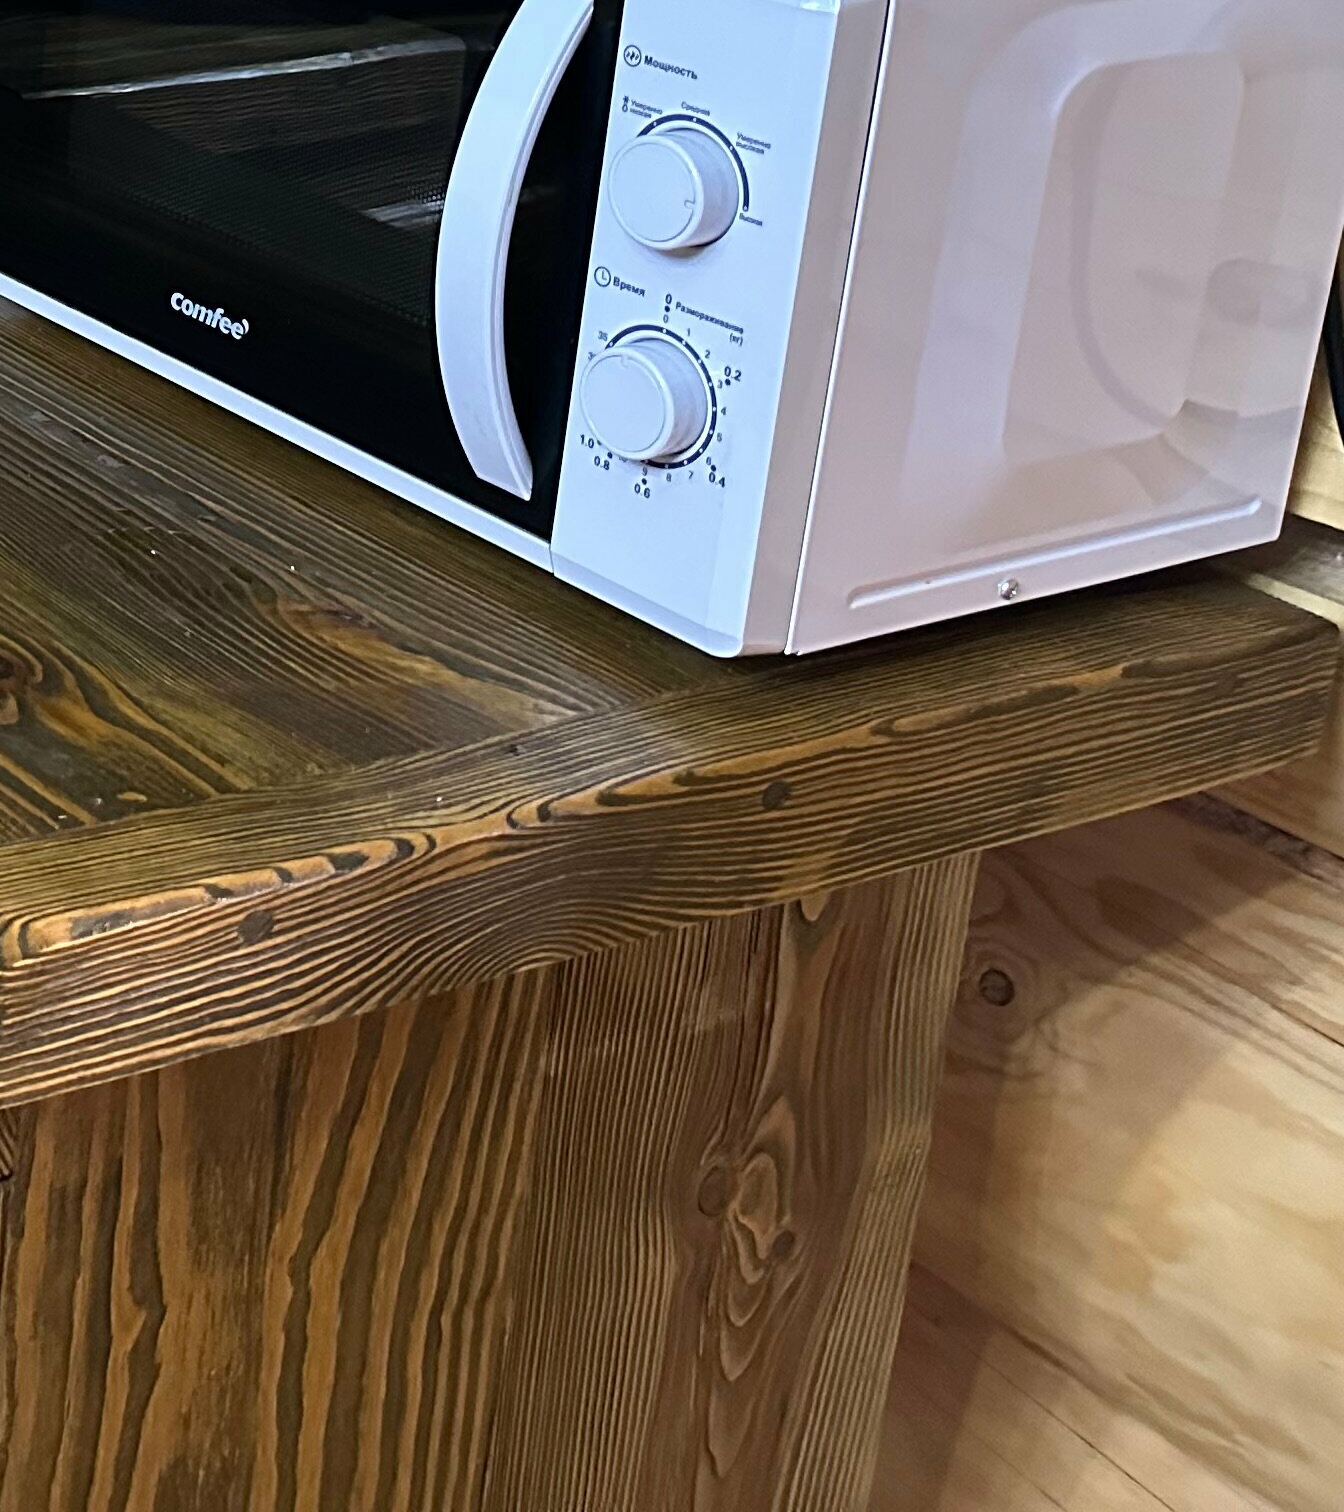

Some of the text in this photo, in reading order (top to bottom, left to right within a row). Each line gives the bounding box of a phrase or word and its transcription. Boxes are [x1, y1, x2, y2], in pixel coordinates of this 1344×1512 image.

[644, 54, 698, 80] Мощность
[613, 276, 645, 297] Время
[665, 293, 672, 305] 0
[598, 331, 608, 341] 35
[705, 349, 711, 359] 2
[724, 366, 742, 382] 0.2
[717, 380, 723, 389] 3
[720, 406, 727, 416] 4
[580, 434, 595, 449] 1.0
[594, 455, 610, 471] 0.8
[666, 473, 672, 482] 8
[708, 471, 726, 488] 0.4
[634, 483, 651, 499] 0.6
